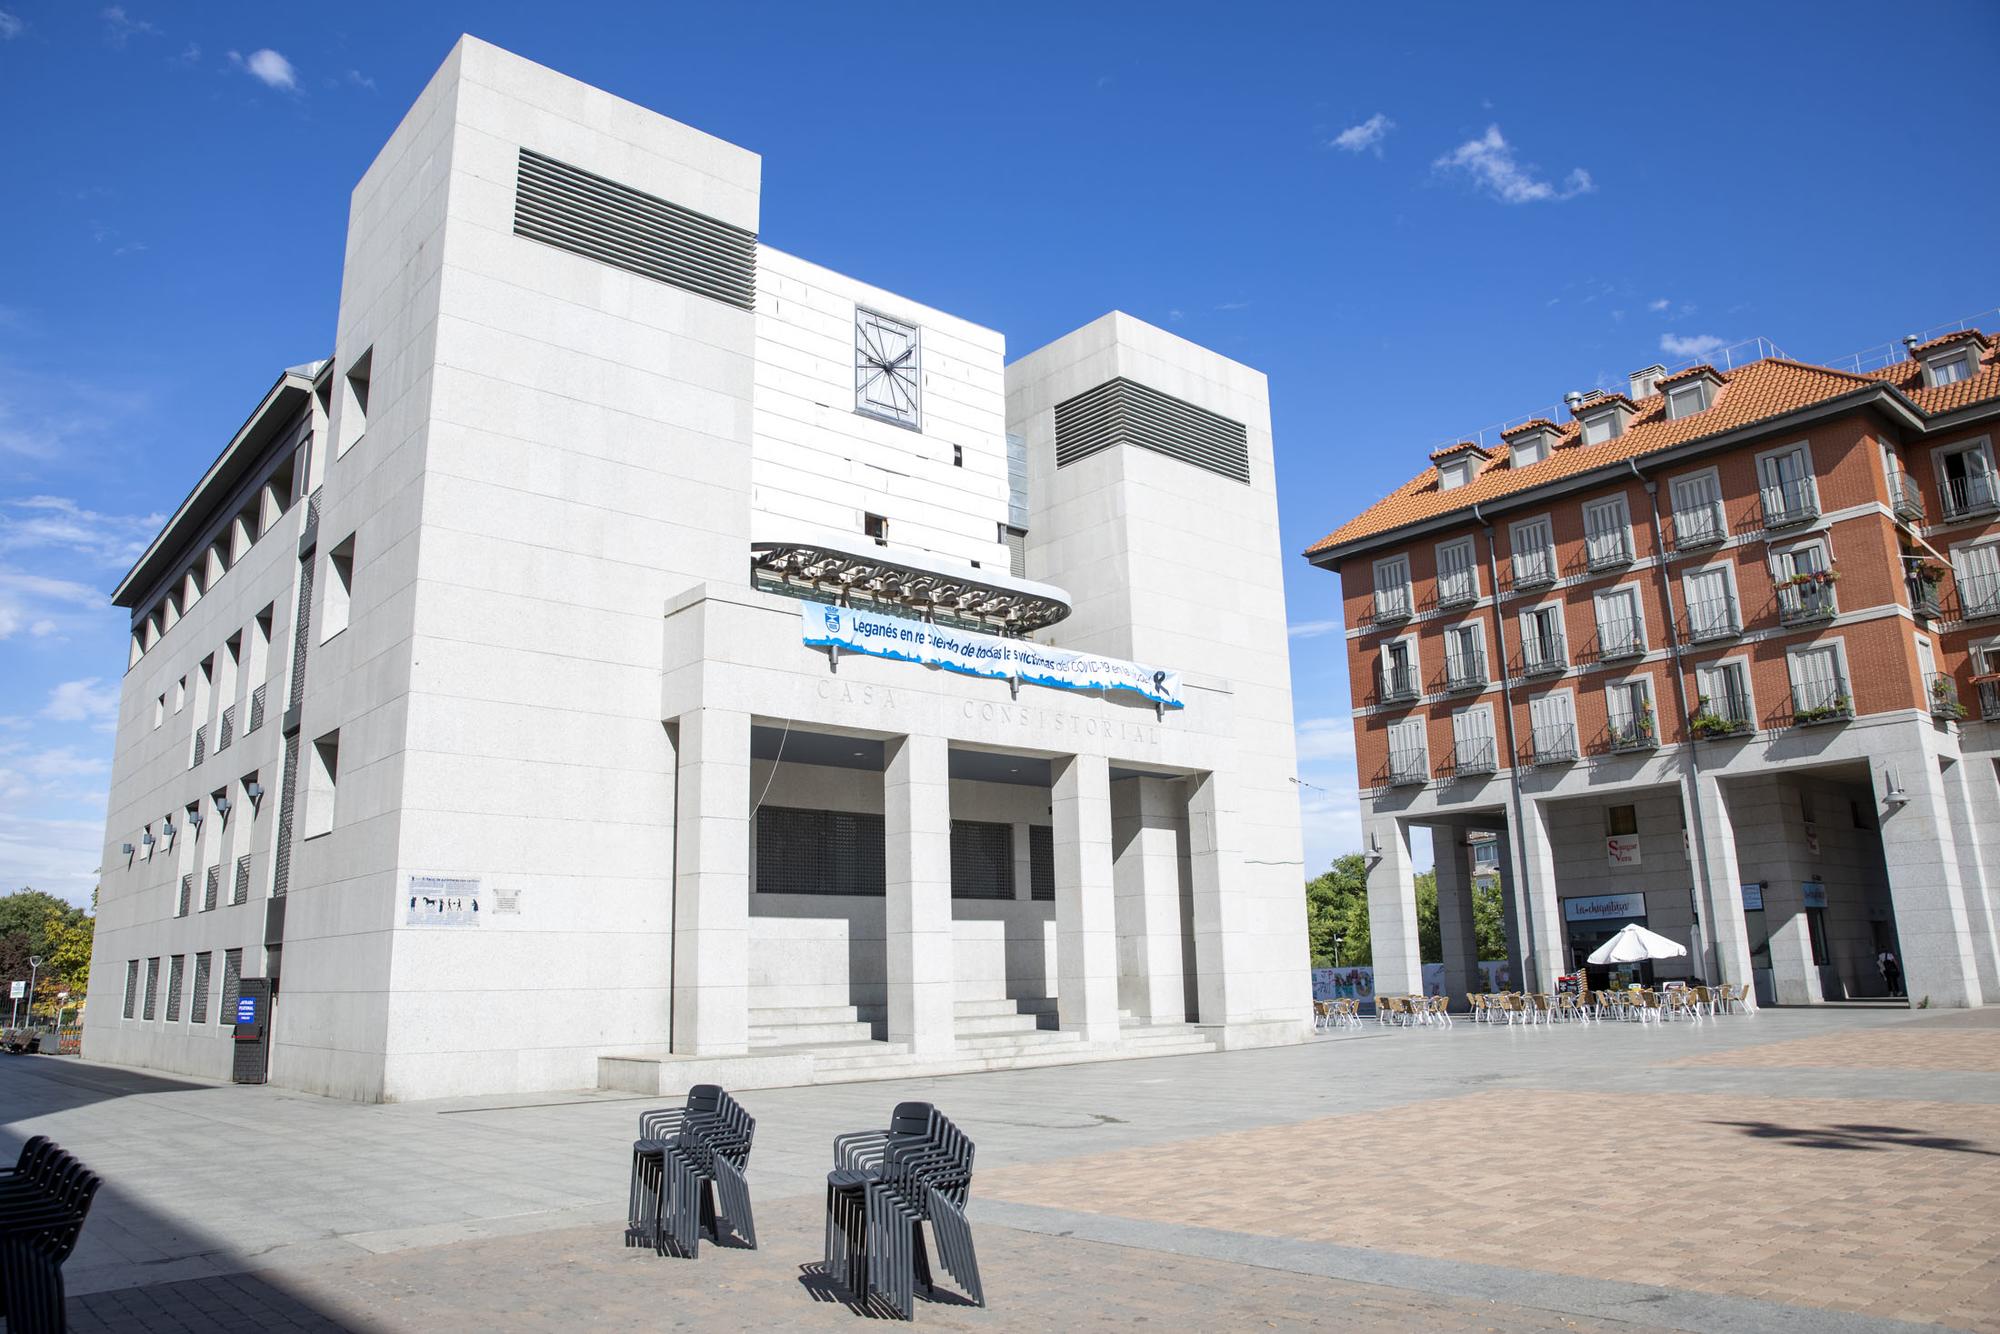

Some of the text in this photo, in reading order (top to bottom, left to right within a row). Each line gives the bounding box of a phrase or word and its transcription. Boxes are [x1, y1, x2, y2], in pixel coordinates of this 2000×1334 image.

[853, 617, 897, 638] Leganés
[900, 628, 913, 642] en
[961, 642, 975, 657] de
[817, 679, 896, 709] CASA
[963, 700, 1158, 745] CONSISTORIAL
